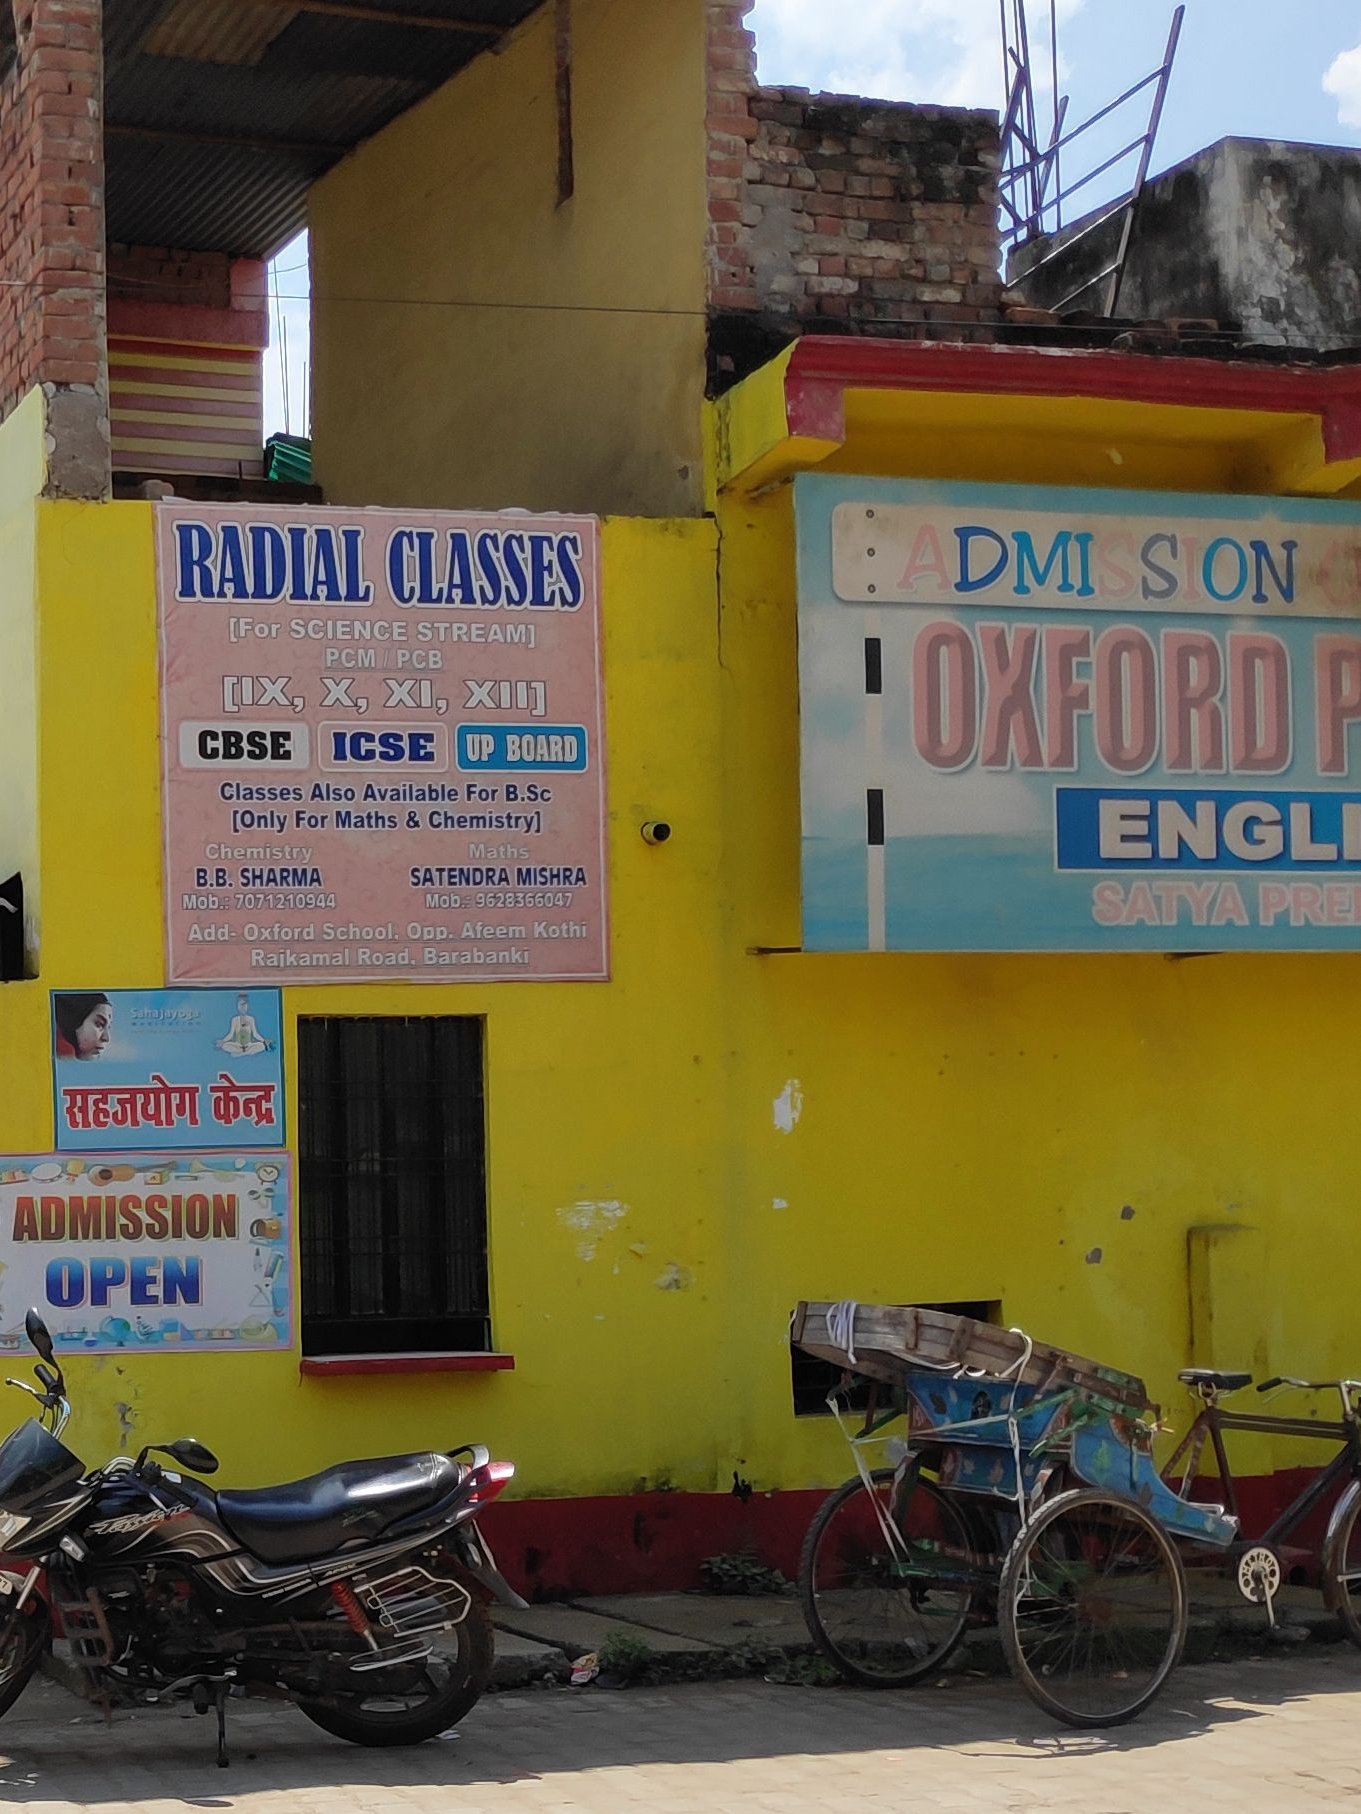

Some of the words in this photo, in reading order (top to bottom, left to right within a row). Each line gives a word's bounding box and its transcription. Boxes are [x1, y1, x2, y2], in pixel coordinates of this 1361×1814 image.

[175, 521, 373, 604] RADIAL
[386, 527, 583, 610] CLASSES
[897, 525, 1298, 604] ADMISSION
[229, 617, 280, 642] [For
[289, 620, 408, 641] SCIENCE
[416, 621, 535, 647] STREAM]
[326, 648, 376, 668] PCM
[397, 649, 443, 669] PCB
[223, 676, 306, 713] [IX,
[319, 677, 369, 714] X,
[383, 678, 448, 715] XI,
[462, 679, 547, 717] XII]
[912, 620, 1294, 774] OXFORD
[197, 729, 292, 761] CBSE
[332, 730, 435, 762] ICSE
[465, 733, 496, 763] UP
[506, 734, 579, 764] BOARD
[220, 782, 303, 803] Classes
[310, 782, 356, 803] Also
[363, 783, 459, 803] Available
[466, 784, 499, 803] For
[505, 784, 552, 804] B.Sc
[232, 810, 287, 833] [Only
[295, 811, 329, 829] For
[335, 811, 398, 829] Maths
[405, 811, 421, 829] &
[428, 811, 542, 834] Chemistry]
[205, 843, 312, 864] Chemistry
[468, 843, 530, 861] Maths
[196, 868, 234, 888] B.B.
[240, 868, 322, 888] SHARMA
[410, 867, 510, 888] SATENDRA
[516, 868, 587, 888] MISHRA
[234, 893, 336, 910] 7071210944
[476, 892, 573, 909] 9628366047
[1093, 881, 1249, 926] SATYA
[1259, 882, 1361, 927] PRE
[243, 923, 314, 942] Oxford
[406, 922, 453, 941] Opp.
[461, 921, 527, 940] Afeem
[534, 920, 587, 940] Kothi
[251, 948, 349, 968] Rajkamal
[423, 946, 530, 966] Barabanki
[62, 1072, 199, 1129] सहजयोग
[209, 1072, 276, 1127] केन्द्र
[12, 1193, 238, 1243] ADMISSION
[44, 1256, 203, 1309] OPEN
